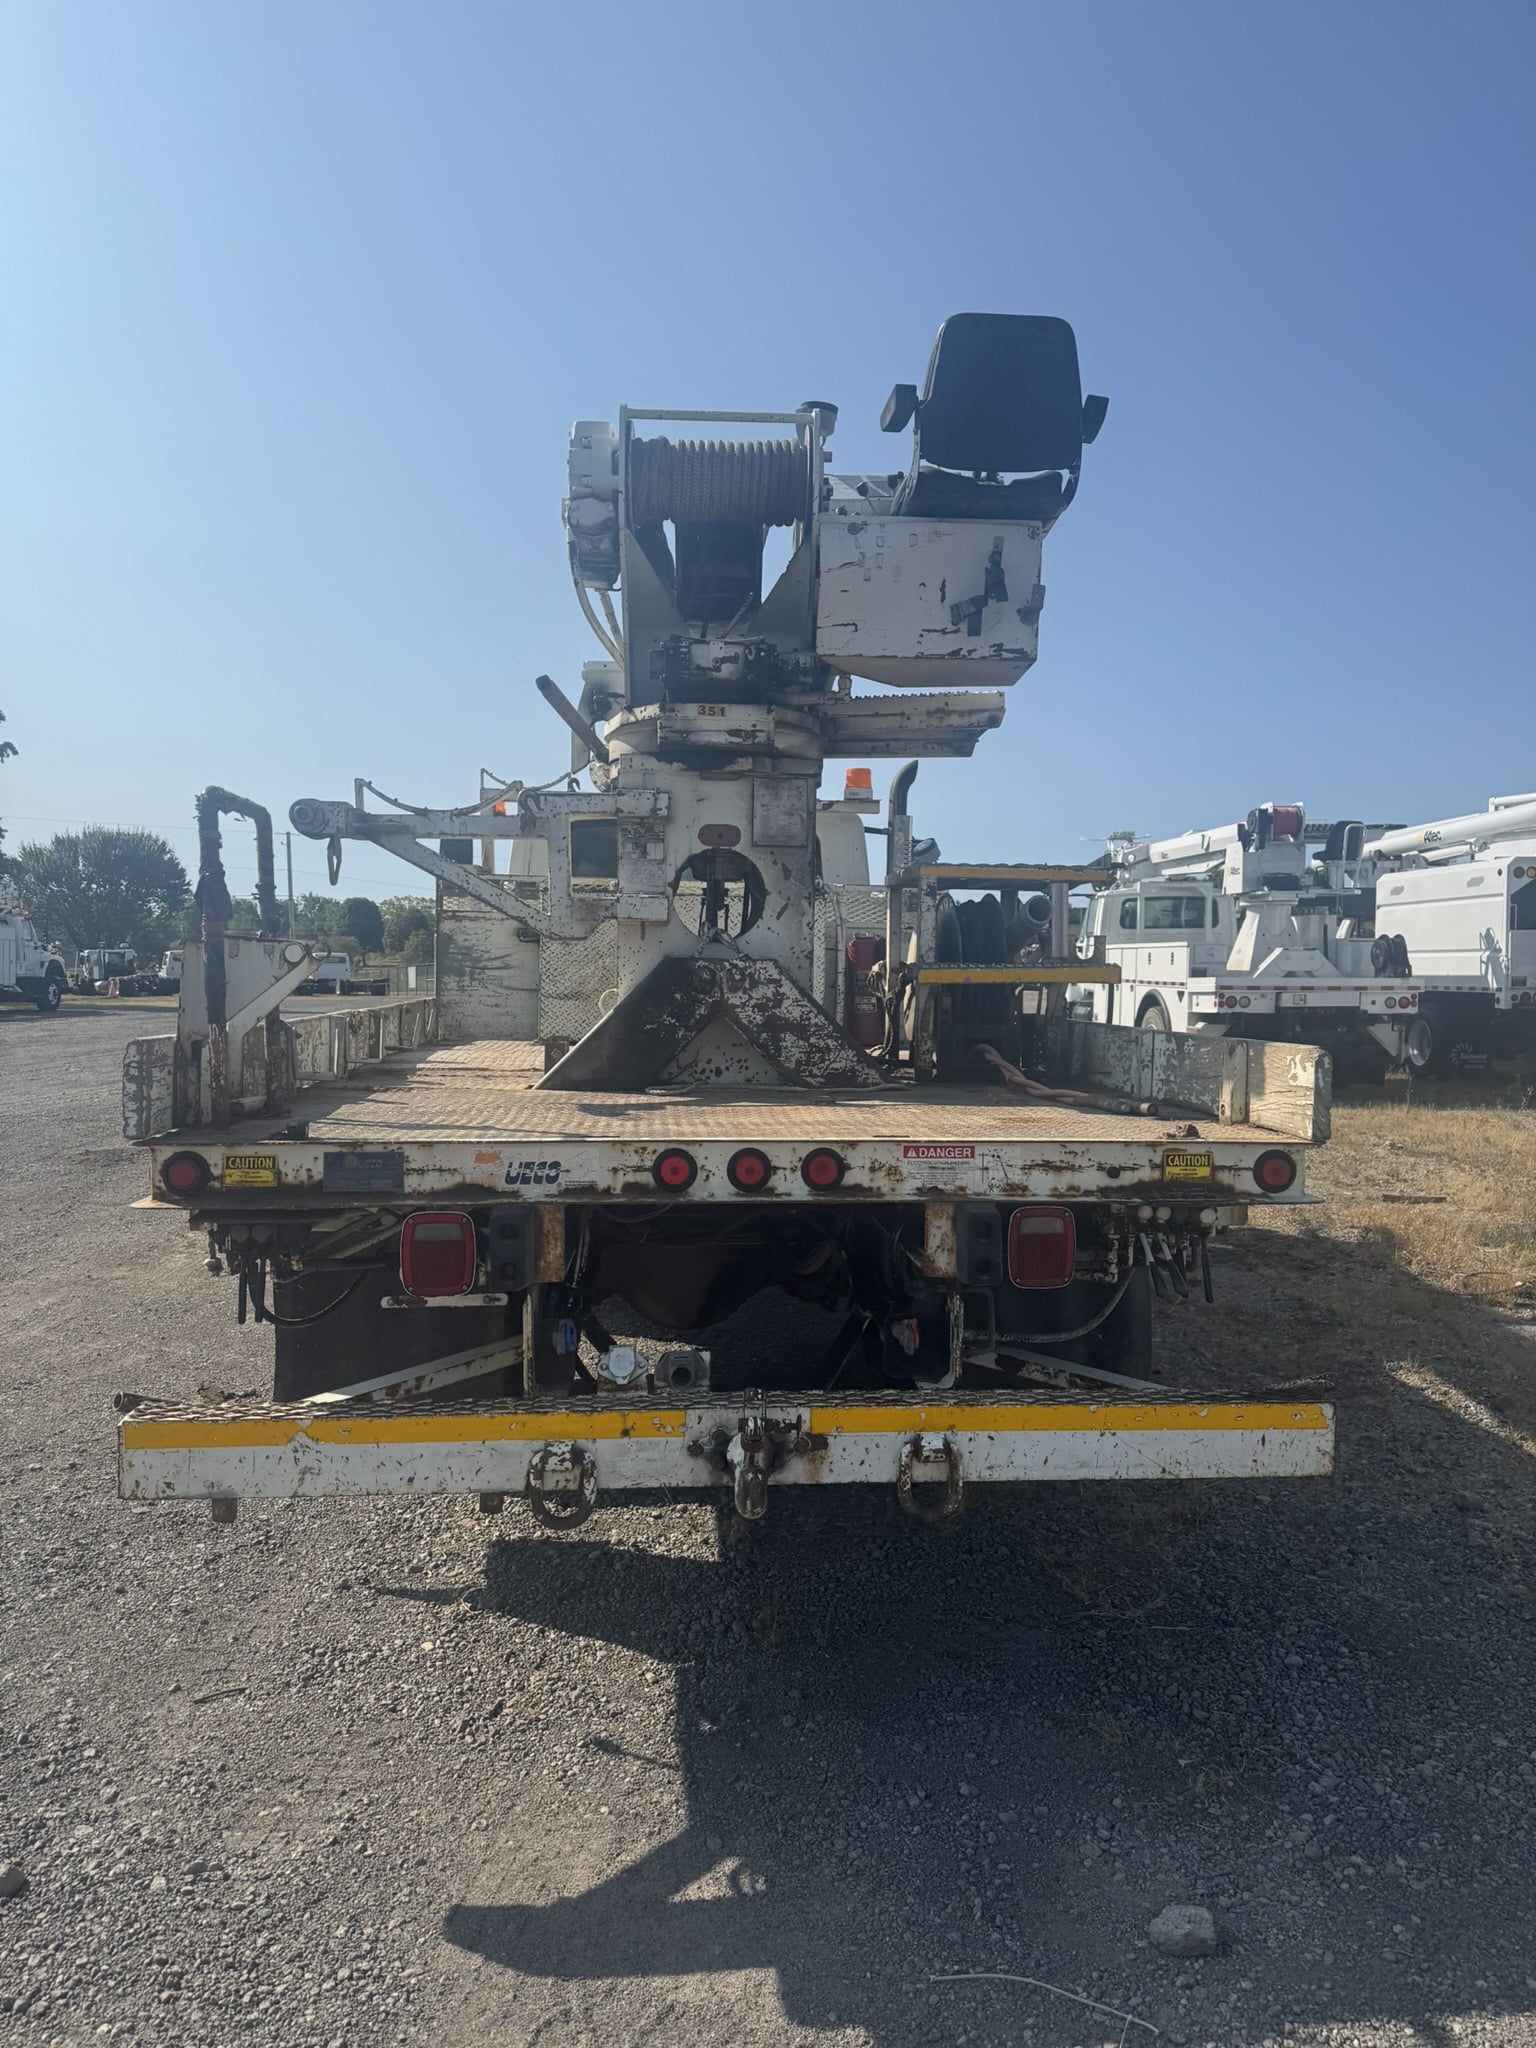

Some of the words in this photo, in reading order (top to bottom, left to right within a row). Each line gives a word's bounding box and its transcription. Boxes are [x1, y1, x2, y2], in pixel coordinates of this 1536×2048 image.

[698, 704, 726, 717] 351
[919, 1147, 972, 1158] DANGER
[228, 1157, 273, 1169] CAUTION
[1168, 1155, 1208, 1166] CAUTION
[504, 1161, 562, 1185] UECO
